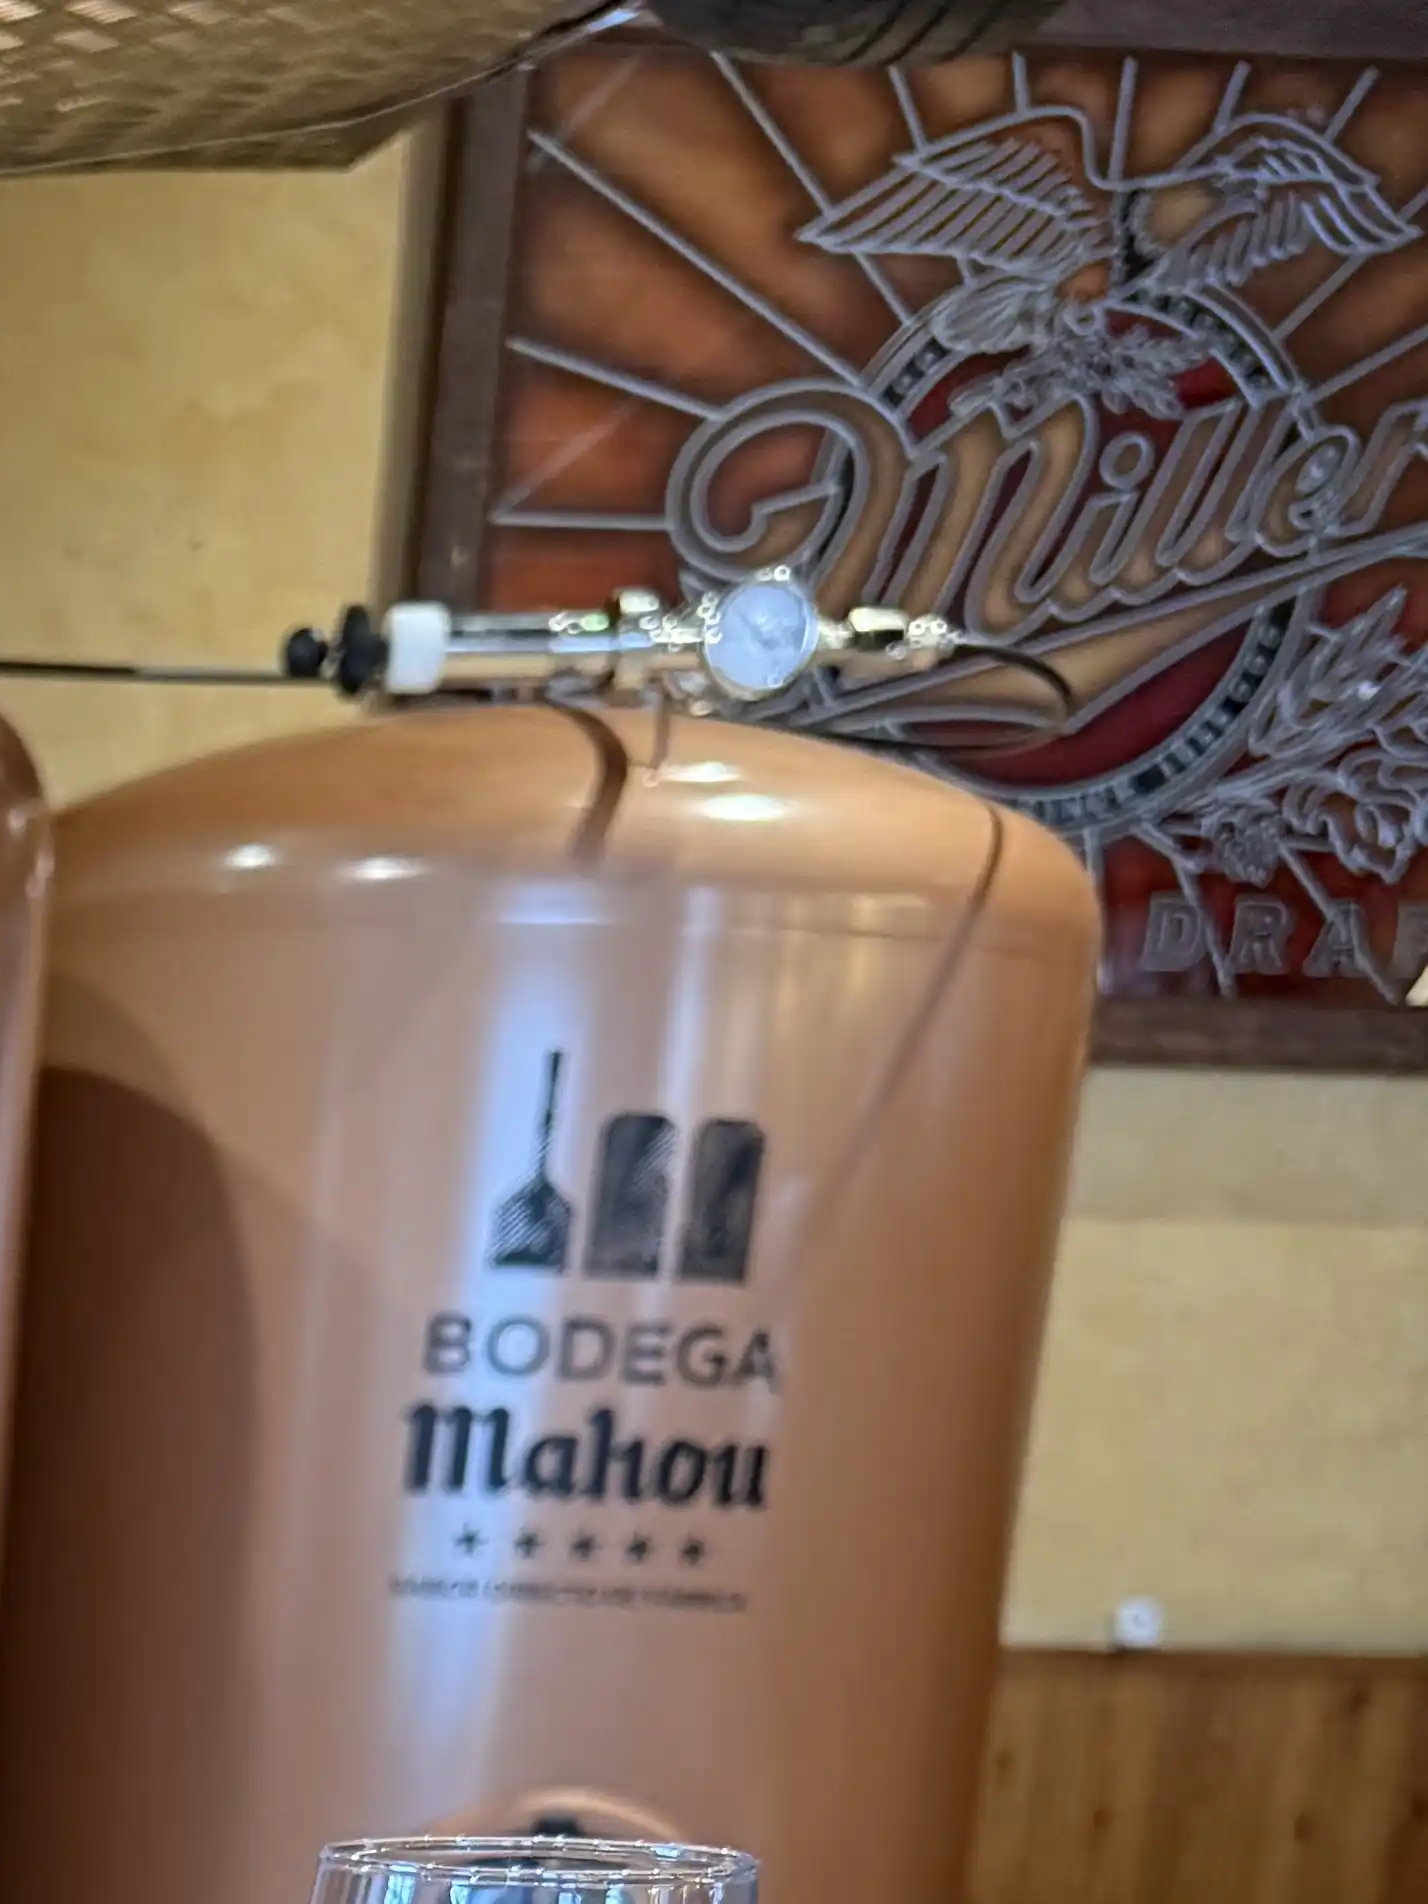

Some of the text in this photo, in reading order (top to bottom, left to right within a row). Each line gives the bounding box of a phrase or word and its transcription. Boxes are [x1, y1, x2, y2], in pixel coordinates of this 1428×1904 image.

[665, 378, 1428, 646] Miller
[423, 1313, 778, 1391] BODEGA
[405, 1403, 768, 1508] Mahou
